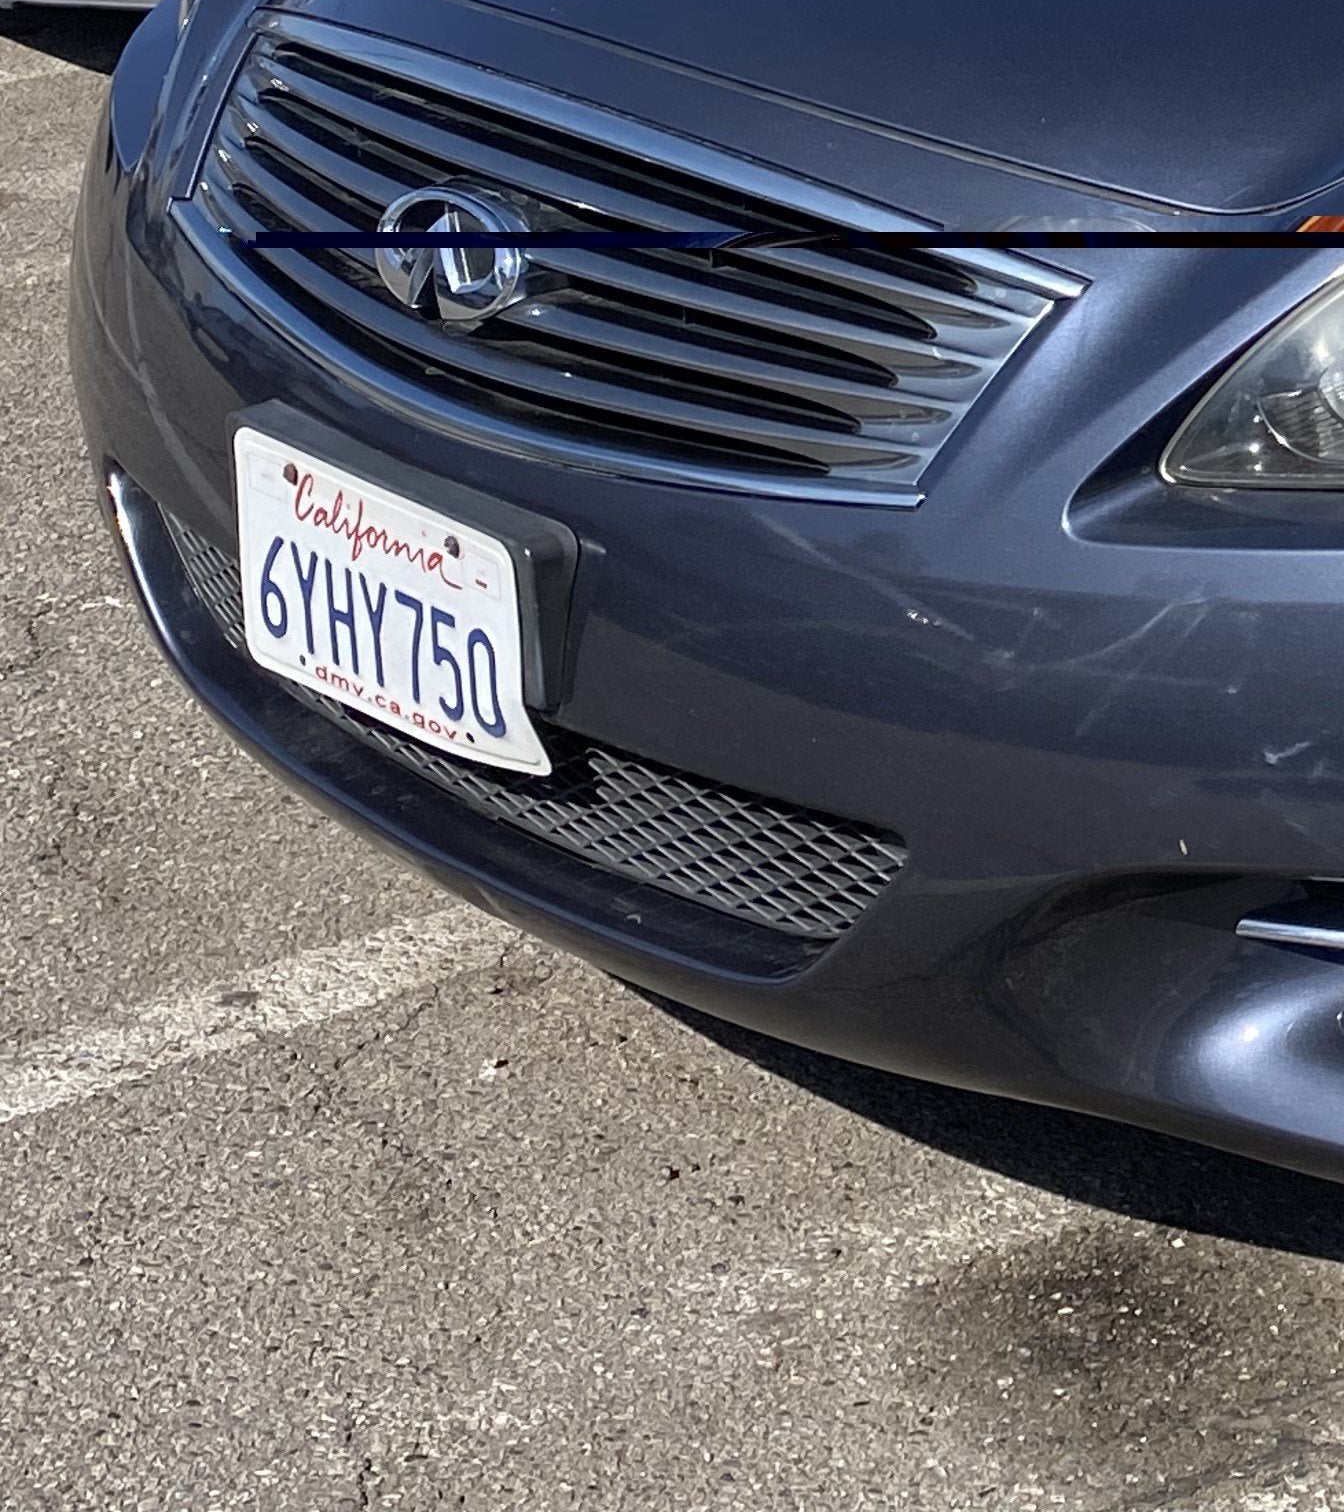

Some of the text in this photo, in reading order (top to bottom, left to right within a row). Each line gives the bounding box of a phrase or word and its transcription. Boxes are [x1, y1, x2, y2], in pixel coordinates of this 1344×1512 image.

[294, 473, 463, 589] California
[260, 536, 507, 738] 6YHY750
[315, 665, 457, 741] dmv.ca.gov
